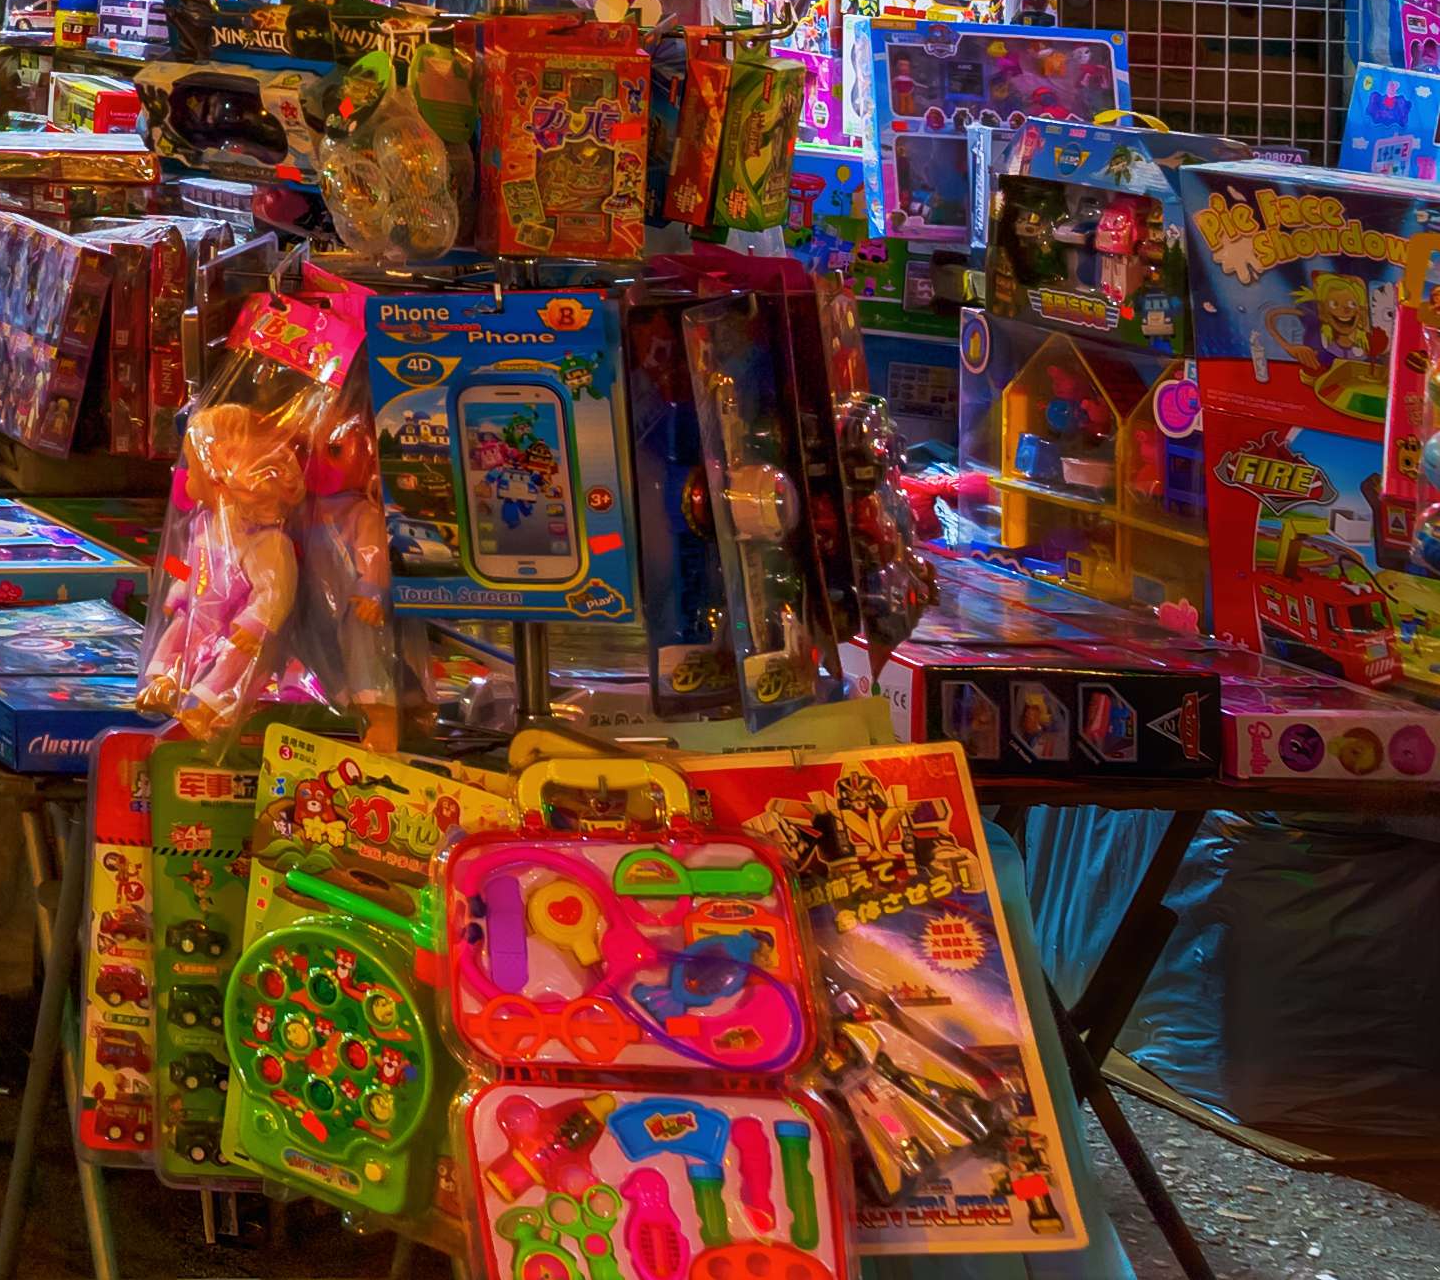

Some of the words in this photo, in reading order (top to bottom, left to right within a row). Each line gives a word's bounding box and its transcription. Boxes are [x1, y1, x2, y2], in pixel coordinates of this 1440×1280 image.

[1196, 190, 1258, 250] Pie
[1258, 188, 1346, 229] Face
[380, 304, 450, 323] Phone
[467, 330, 555, 344] Phone
[406, 358, 431, 373] 4D
[1235, 454, 1320, 497] FIRE
[398, 586, 452, 603] Touch
[458, 588, 523, 605] Screen
[585, 592, 616, 612] Play!
